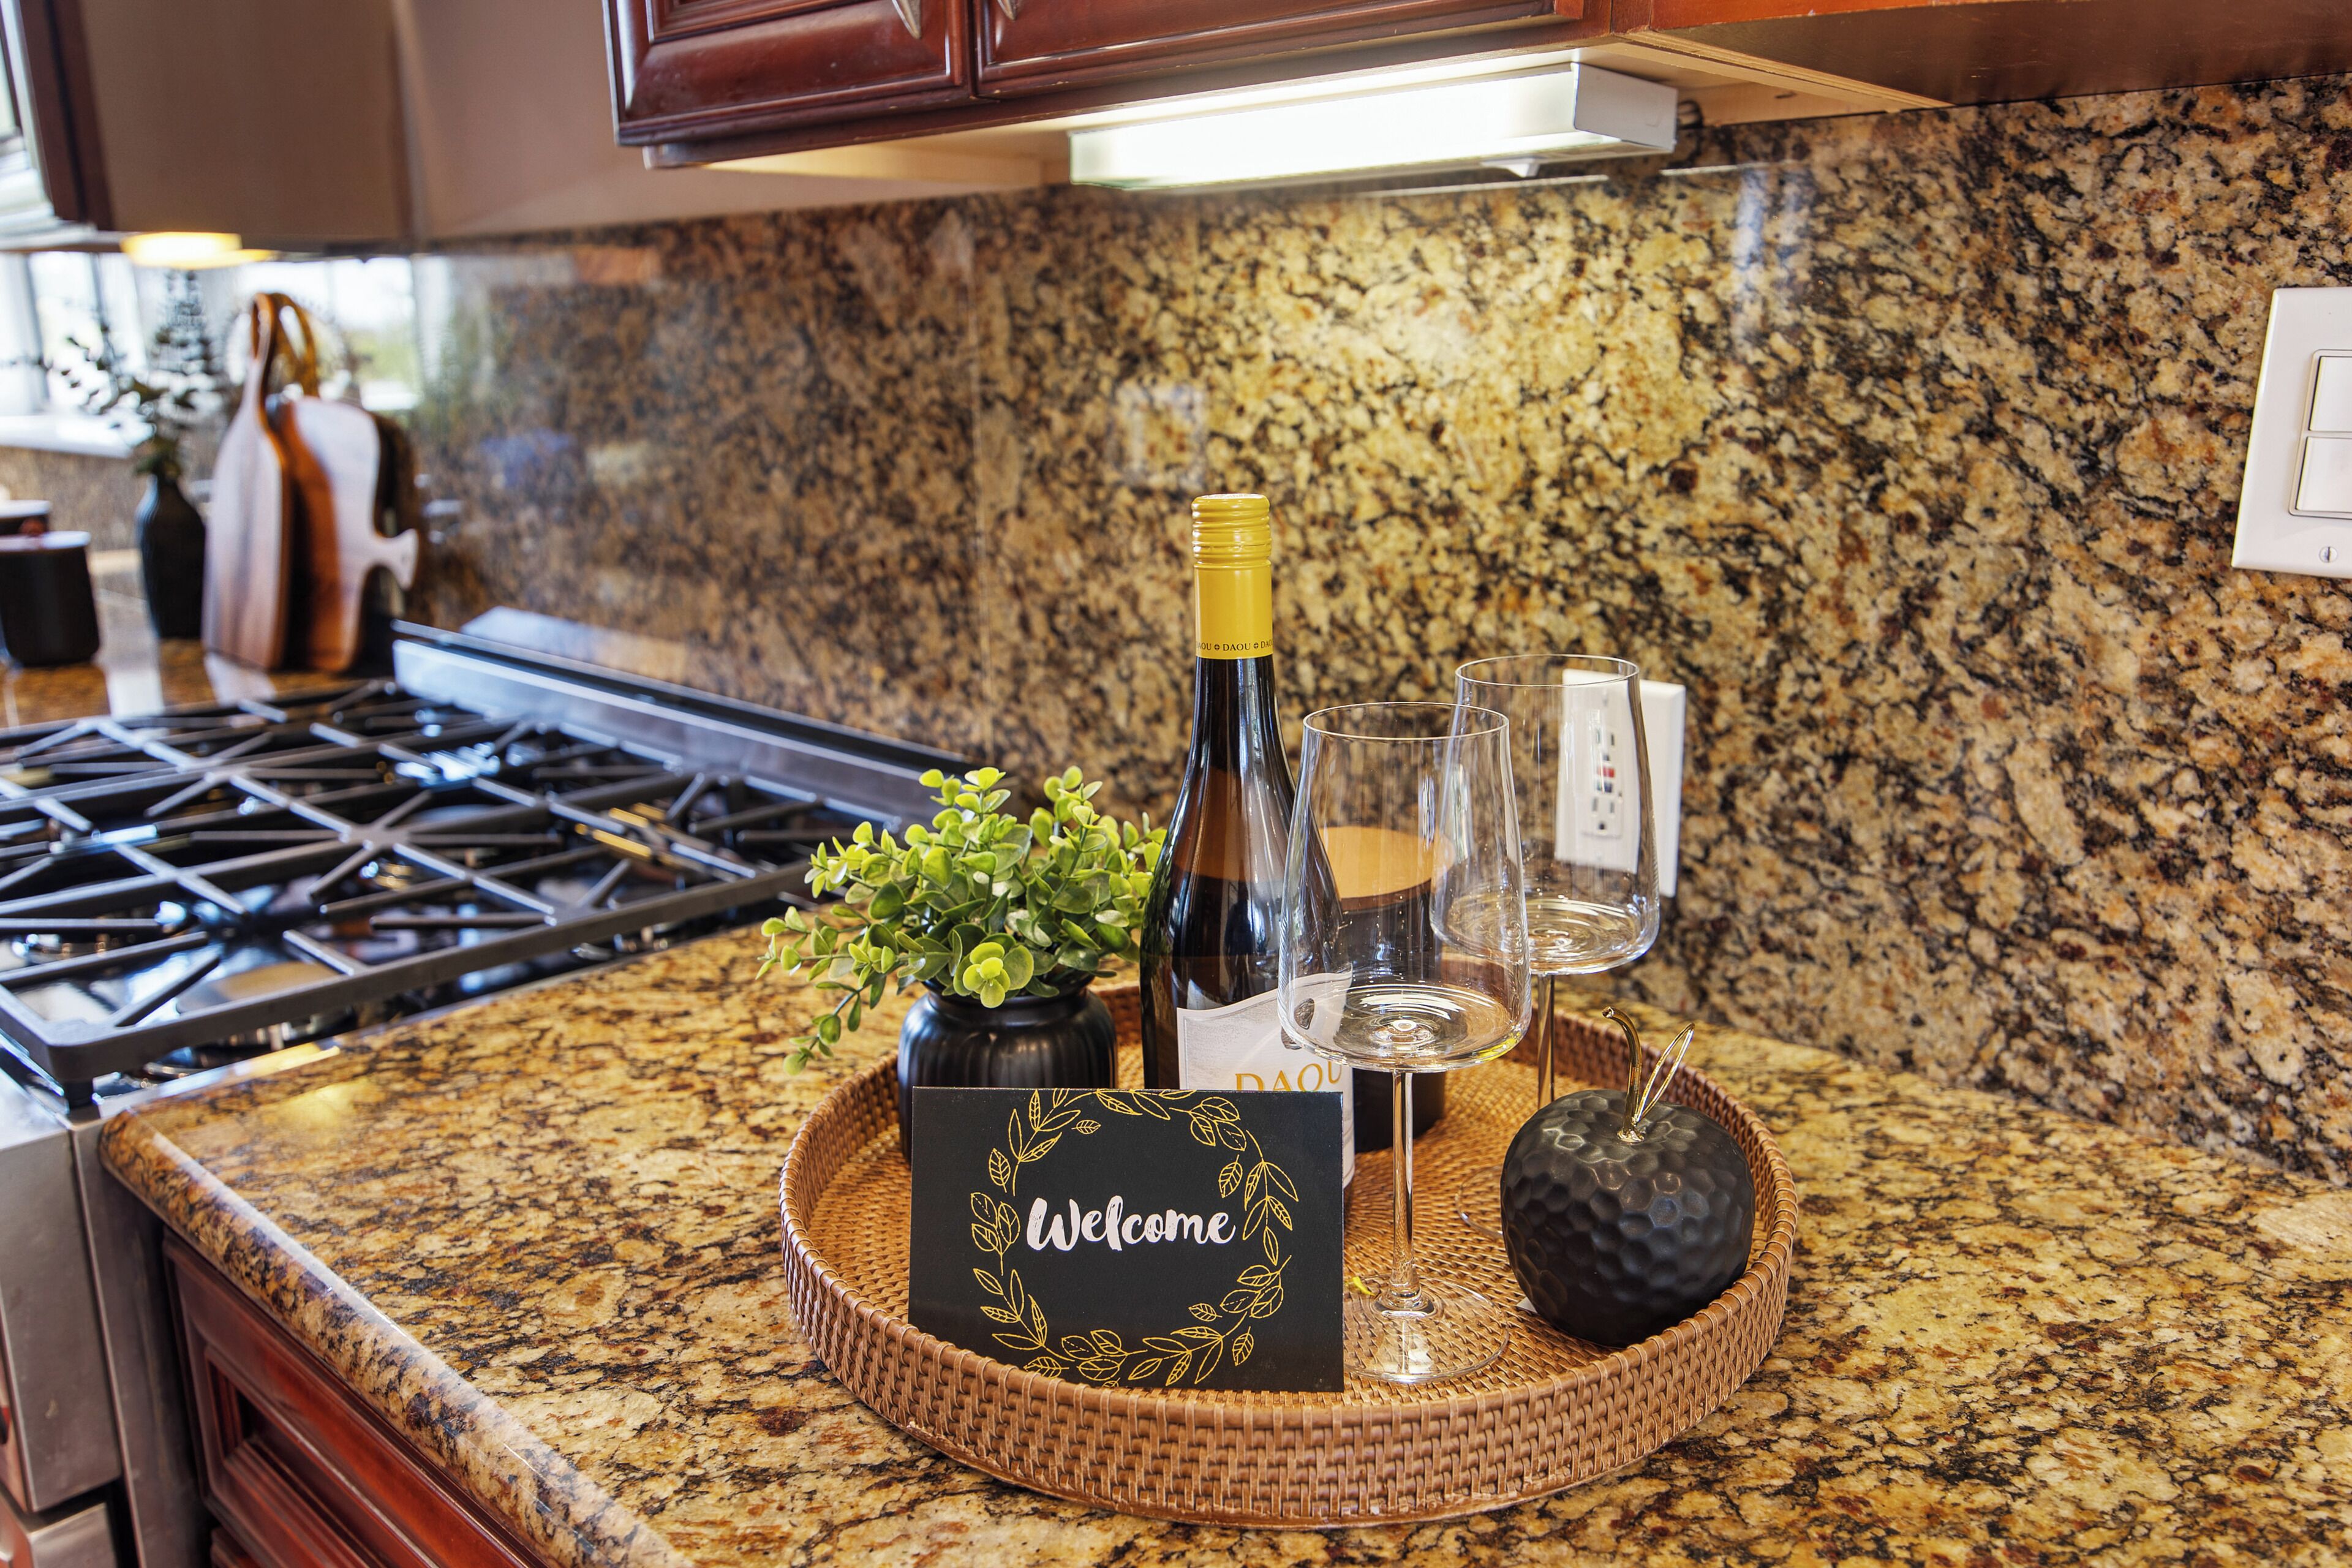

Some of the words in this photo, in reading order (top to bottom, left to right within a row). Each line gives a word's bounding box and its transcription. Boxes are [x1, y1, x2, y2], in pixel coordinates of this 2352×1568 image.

[1261, 639, 1273, 649] DAO
[1235, 1061, 1342, 1091] DAOU
[1027, 1195, 1236, 1251] Welcome
